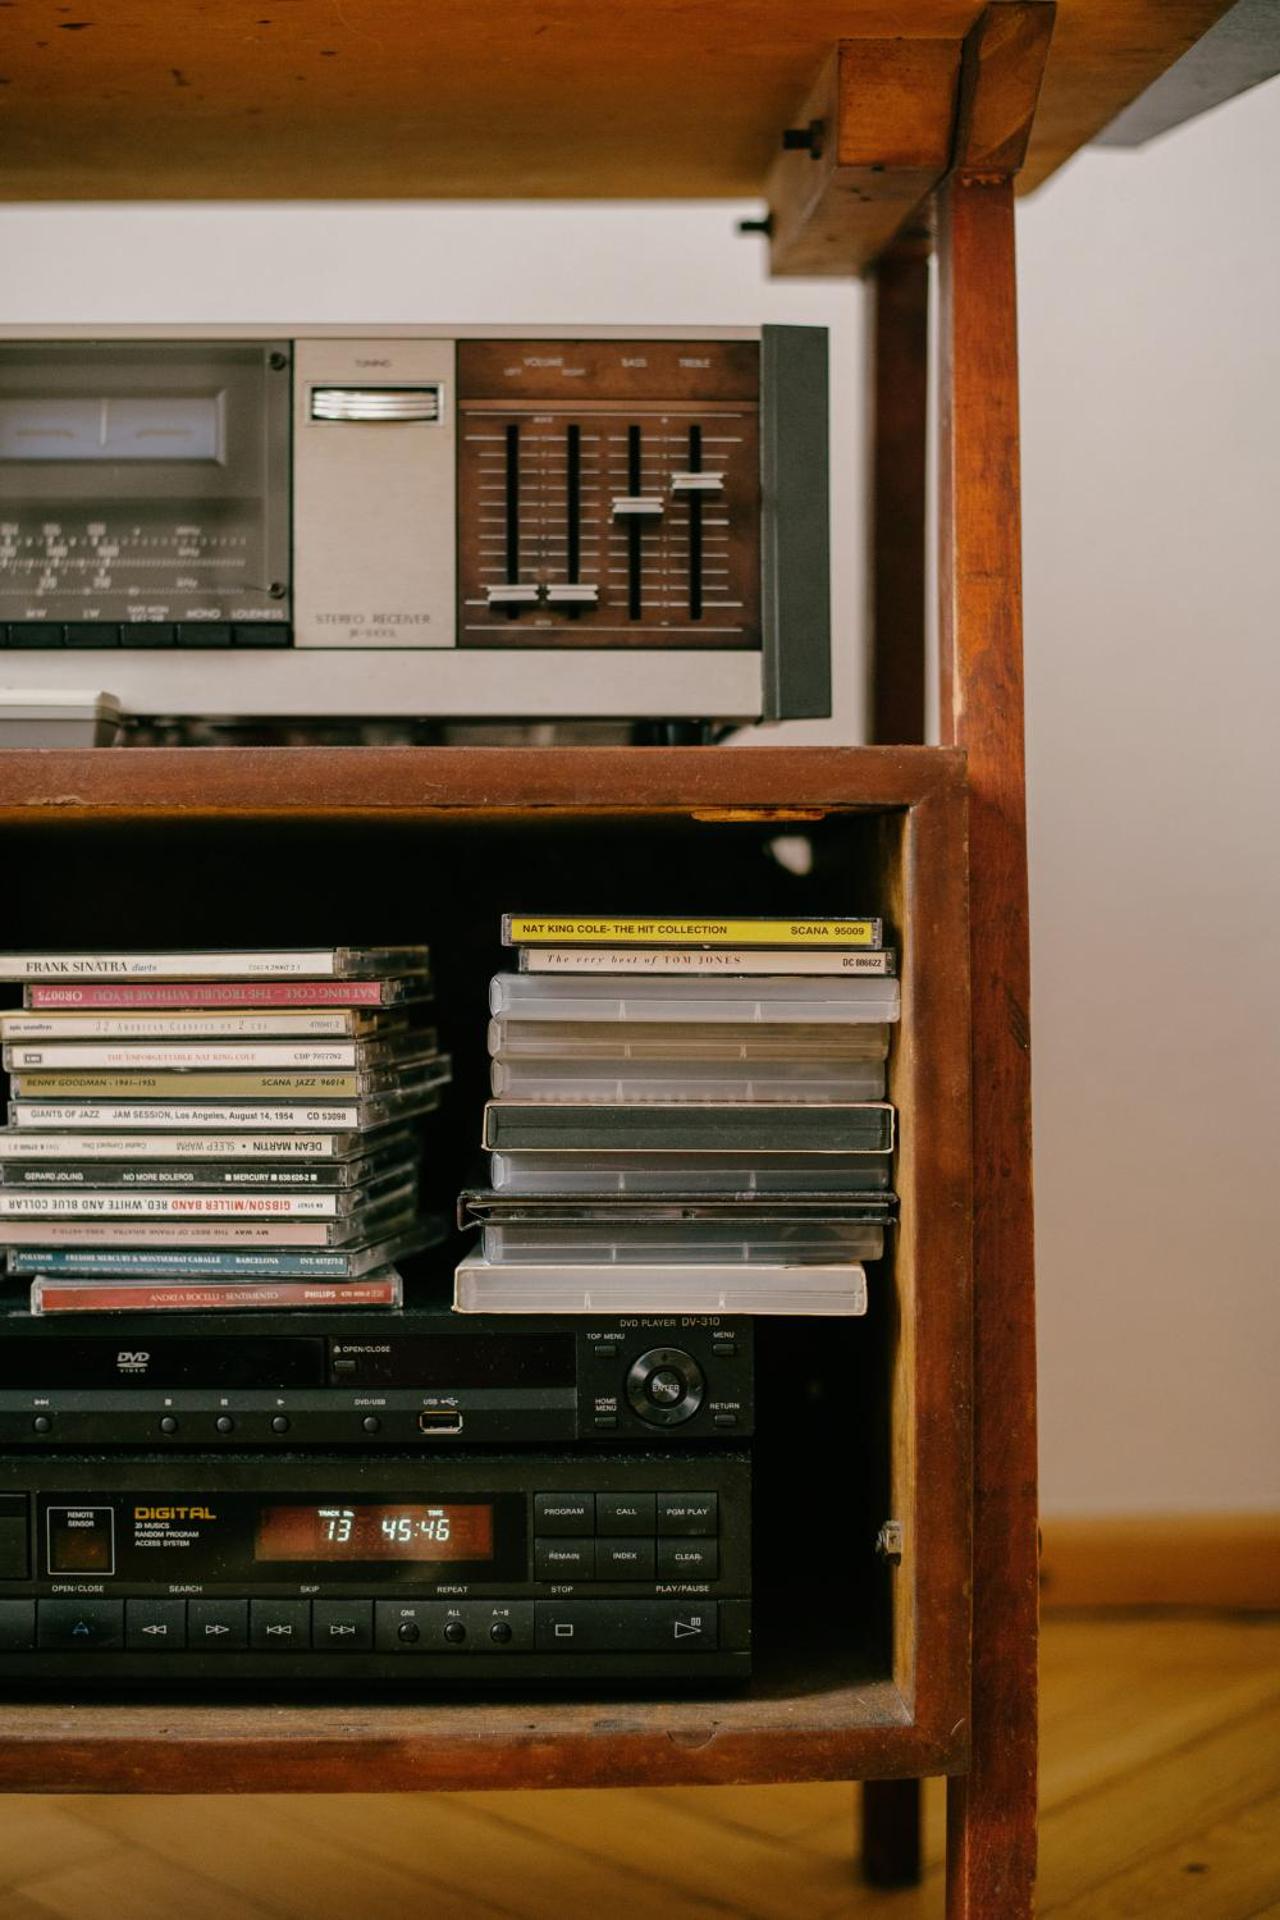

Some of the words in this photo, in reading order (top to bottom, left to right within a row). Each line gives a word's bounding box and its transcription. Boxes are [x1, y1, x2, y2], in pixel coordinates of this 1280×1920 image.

[523, 357, 564, 367] VOLUME
[620, 358, 647, 368] BASS
[679, 358, 711, 368] TREBLE
[186, 608, 221, 619] MONO
[231, 608, 283, 619] LOUDNESS
[315, 613, 365, 625] STEREO
[372, 613, 431, 625] RECEIVER
[523, 924, 544, 934] NAT
[548, 924, 574, 934] KING
[614, 925, 634, 934] THE
[638, 925, 654, 934] HIT
[657, 925, 727, 935] COLLECTION
[790, 926, 829, 936] SCANA
[834, 926, 865, 936] 95009
[547, 955, 569, 964] The
[576, 957, 604, 966] very
[611, 955, 638, 964] best
[644, 955, 657, 965] of
[665, 956, 691, 964] TOM
[699, 955, 742, 964] JONES
[842, 958, 854, 967] DC
[25, 961, 69, 972] FRANK
[72, 961, 128, 972] SINATRA
[131, 962, 157, 972] duets
[38, 991, 83, 1002] OR0075
[93, 990, 121, 1001] YOU
[122, 990, 133, 1001] IS
[135, 990, 153, 1000] ME
[154, 990, 189, 1000] WITH
[192, 989, 245, 1000] TROUBLE
[247, 988, 272, 999] THE
[319, 987, 353, 998] KING
[353, 987, 378, 998] NAT
[106, 1053, 124, 1061] THE
[195, 1053, 211, 1061] NAT
[212, 1053, 233, 1061] KING
[27, 1078, 57, 1087] BENNY
[58, 1078, 107, 1087] GOODMAN
[261, 1078, 292, 1087] SCANA
[295, 1078, 316, 1088] JAZZ
[31, 1109, 62, 1118] GIANTS
[65, 1109, 76, 1118] OF
[79, 1109, 100, 1118] JAZZ
[113, 1110, 131, 1119] JAM
[133, 1110, 174, 1120] SESSION,
[175, 1111, 190, 1120] Los
[191, 1111, 227, 1122] Angeles,
[229, 1112, 258, 1121] August
[260, 1112, 272, 1121] 14,
[275, 1112, 294, 1121] 1954
[306, 1112, 320, 1121] CD
[176, 1142, 204, 1152] WARM
[206, 1142, 235, 1152] SLEEP
[252, 1142, 291, 1151] MARTIN
[294, 1142, 322, 1151] DEAN
[24, 1172, 55, 1181] GERARD
[56, 1172, 84, 1181] JOLING
[122, 1172, 135, 1181] NO
[136, 1172, 158, 1181] MORE
[159, 1172, 194, 1181] BOLEROS
[233, 1173, 270, 1181] MERCURY
[8, 1199, 48, 1210] COLLAR
[52, 1199, 78, 1210] BLUE
[82, 1199, 104, 1210] AND
[108, 1199, 143, 1210] WHITE
[144, 1199, 168, 1210] RED,
[171, 1200, 202, 1210] BAND
[205, 1200, 291, 1210] GIBSON/MILLER
[113, 1228, 147, 1236] SINATRA
[235, 1256, 280, 1265] BARCELONA
[150, 1294, 184, 1302] ANDREA
[185, 1293, 220, 1301] BOCELLI
[304, 1290, 336, 1298] PHILIPS
[620, 1319, 638, 1327] DVD
[641, 1319, 677, 1327] PLAYER
[681, 1317, 720, 1326] DV-310
[713, 1331, 735, 1339] MENU
[117, 1352, 150, 1362] DVD
[354, 1398, 386, 1406] DVD/USB
[709, 1402, 740, 1410] RETURN
[134, 1507, 217, 1519] DIGITAL
[317, 1509, 340, 1517] TRACK
[544, 1508, 585, 1516] PROGRAM
[616, 1508, 637, 1516] CALL
[666, 1508, 685, 1516] PGM
[687, 1508, 708, 1516] PLAY
[328, 1519, 352, 1541] 13
[382, 1519, 450, 1541] 45:46
[548, 1552, 580, 1560] REMAIN
[612, 1552, 637, 1560] INDEX
[675, 1553, 700, 1561] CLEAR
[300, 1585, 319, 1593] SKIP
[437, 1585, 468, 1593] REPEAT
[655, 1584, 710, 1592] PLAY/PAUSE
